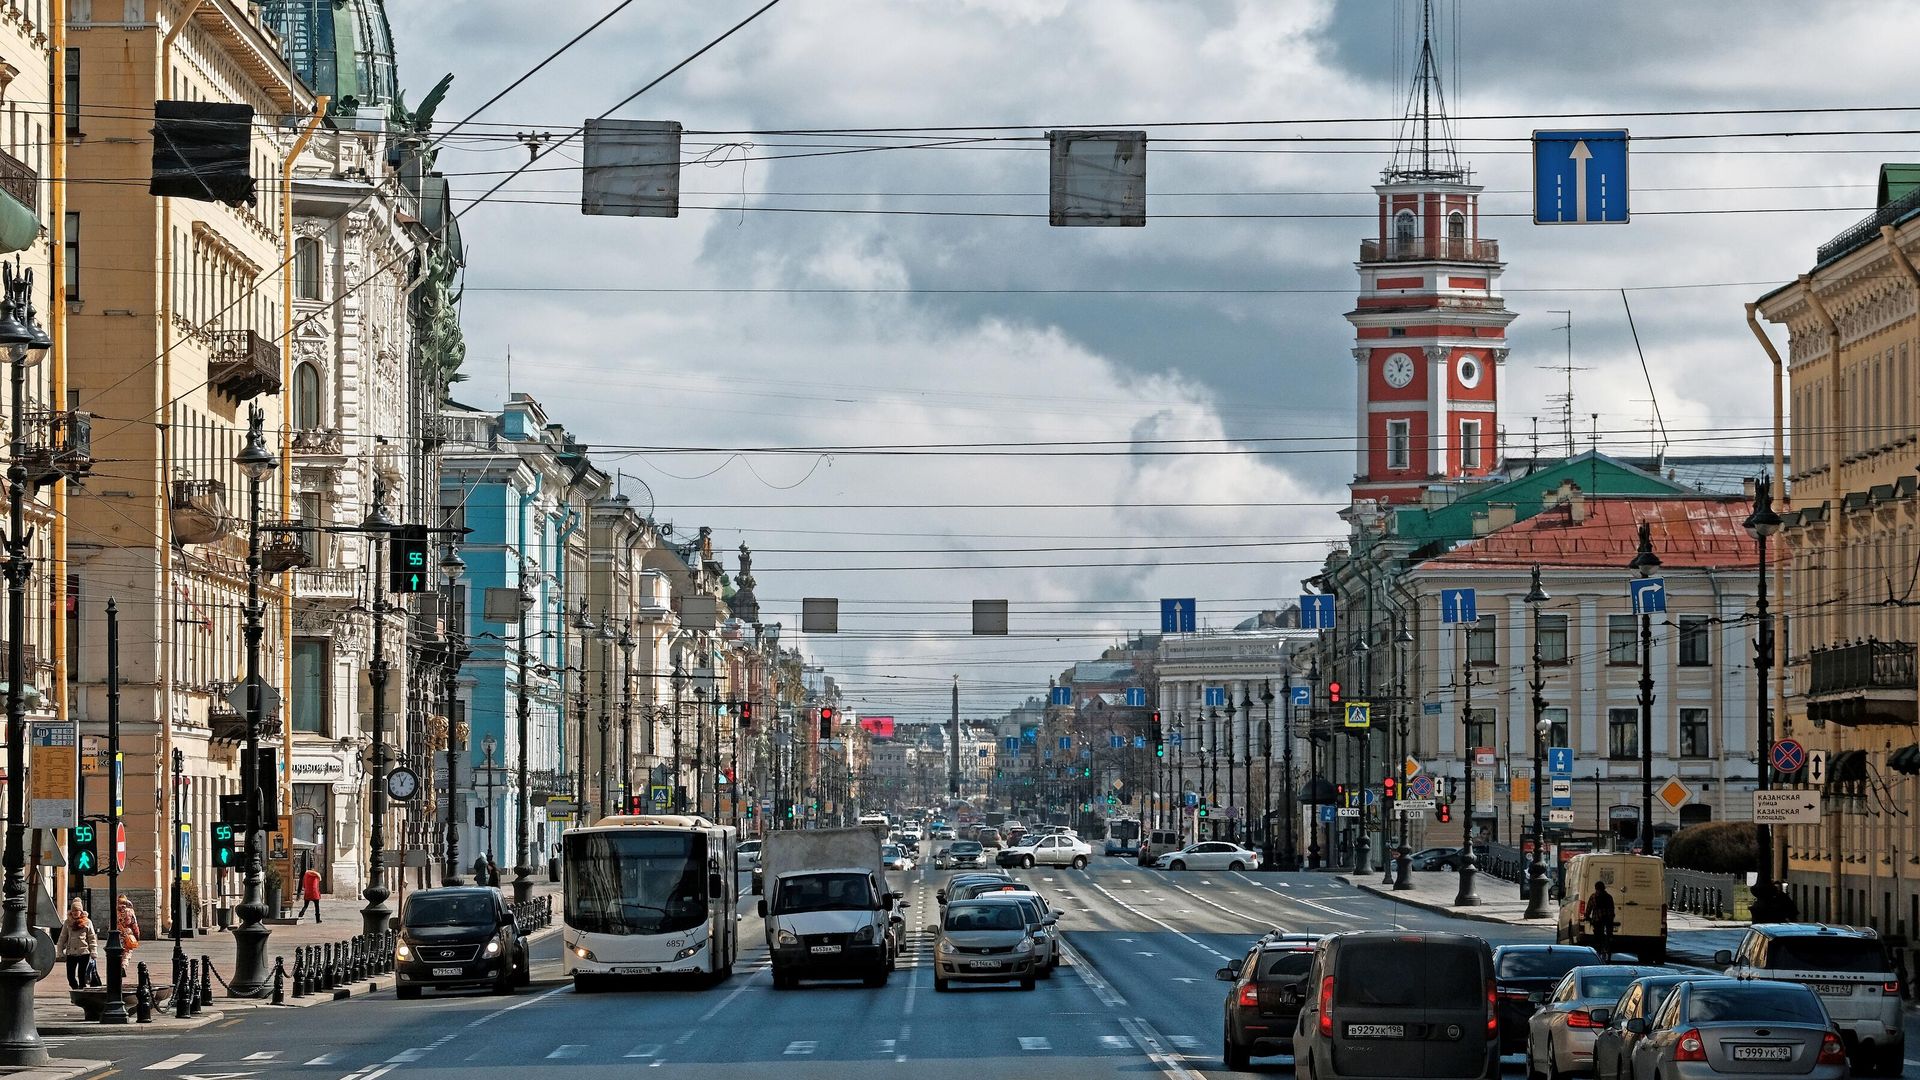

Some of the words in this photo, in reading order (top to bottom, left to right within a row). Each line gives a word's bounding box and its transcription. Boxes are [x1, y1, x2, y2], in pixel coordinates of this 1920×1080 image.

[409, 552, 423, 566] 55
[76, 826, 92, 842] 55
[216, 826, 231, 840] 55
[666, 940, 685, 948] 6857
